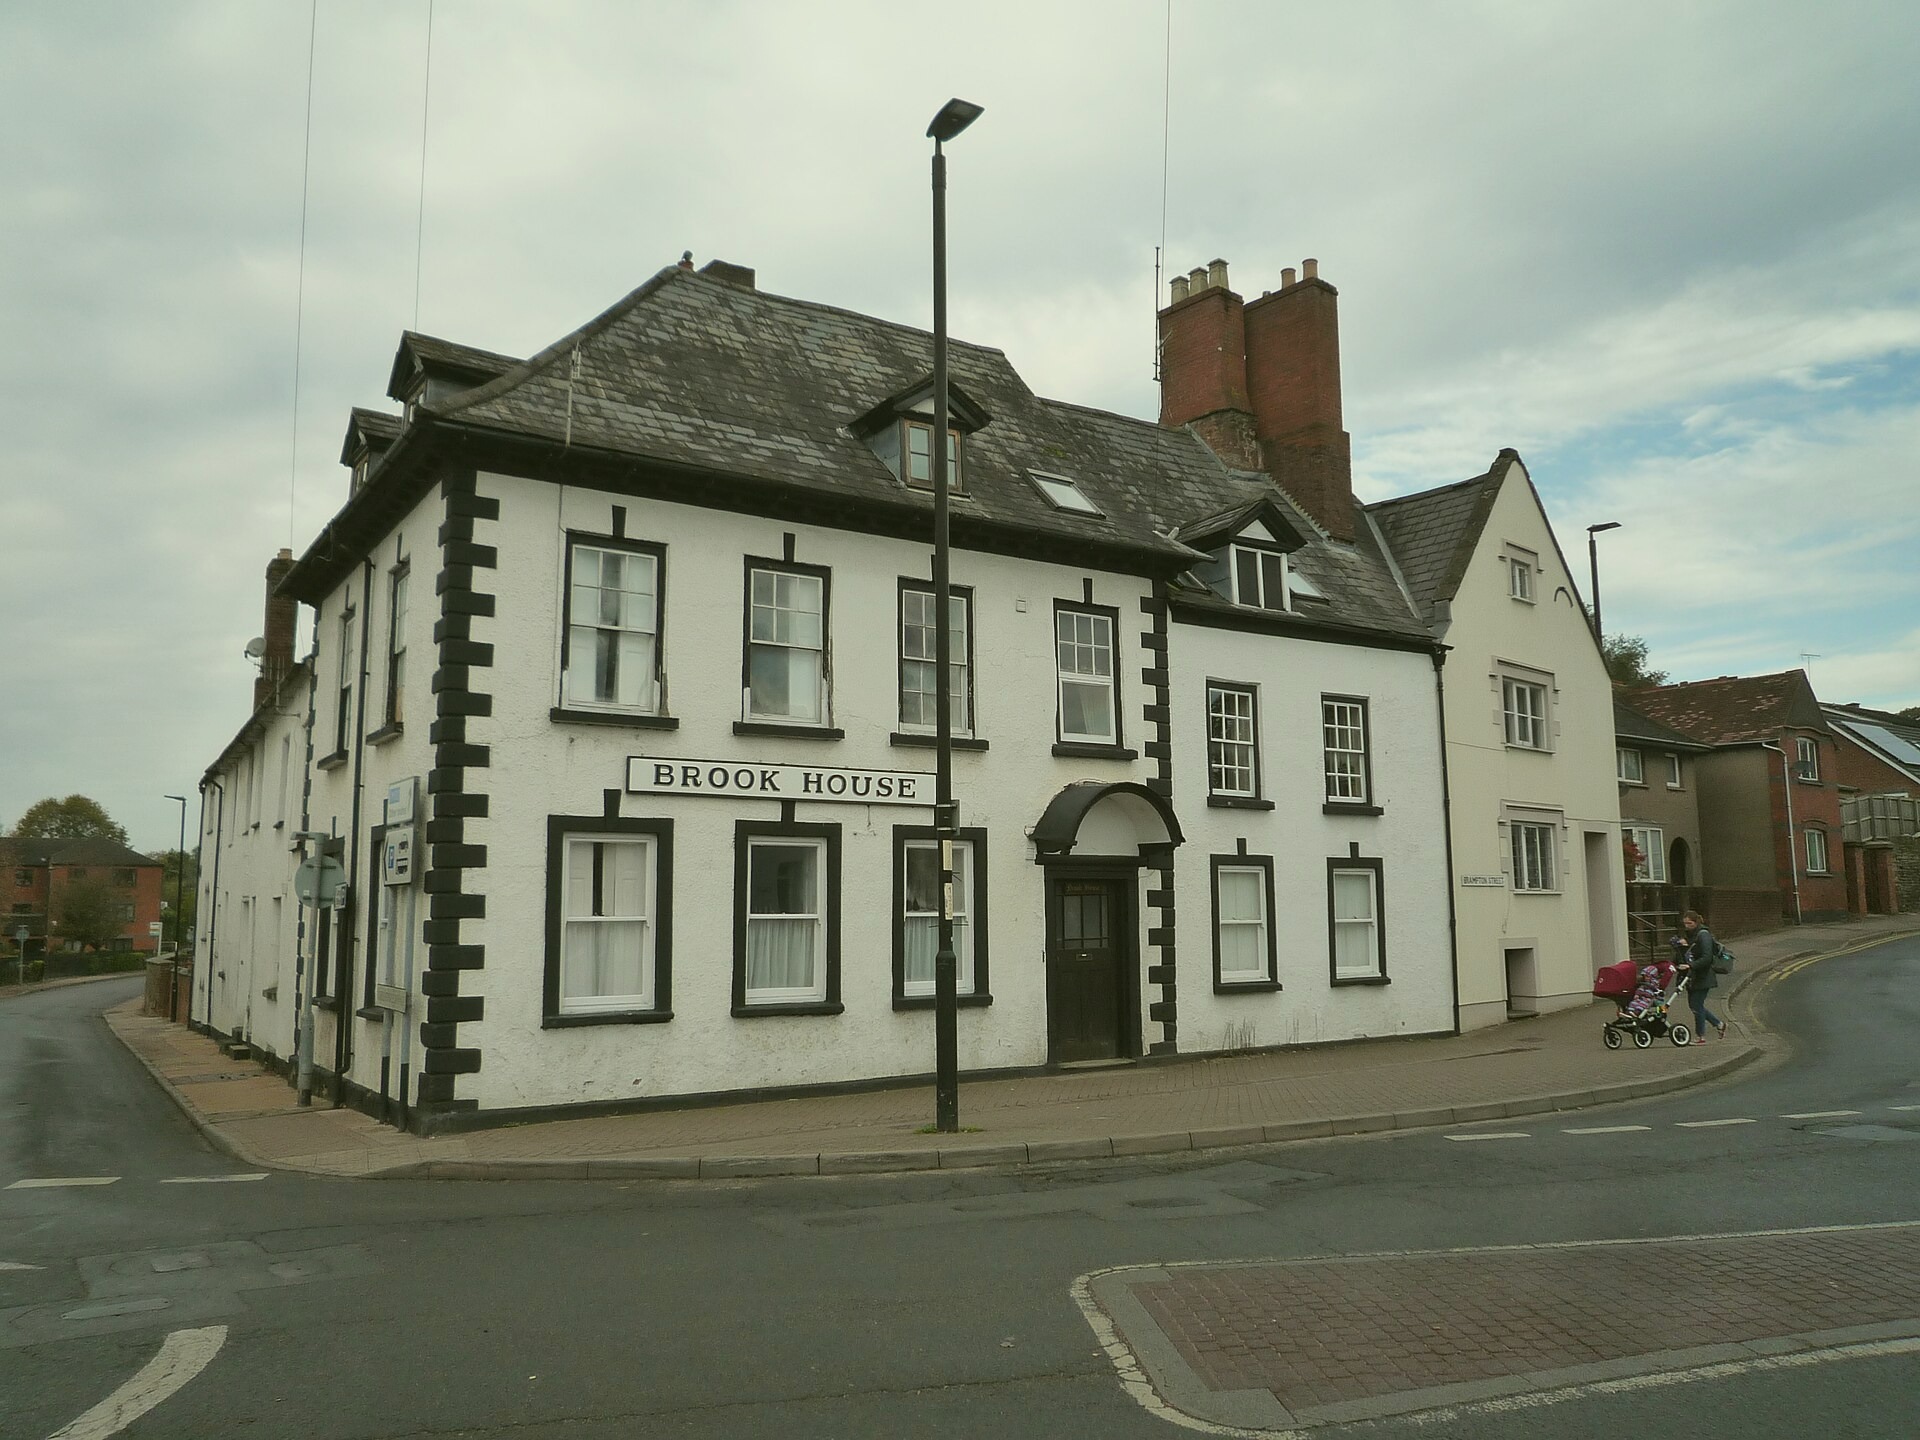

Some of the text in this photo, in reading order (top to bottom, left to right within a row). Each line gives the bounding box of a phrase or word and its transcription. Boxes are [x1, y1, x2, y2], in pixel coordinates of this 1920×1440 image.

[653, 764, 916, 798] BROOK HOUSE
[1463, 876, 1487, 884] BRAMPTON
